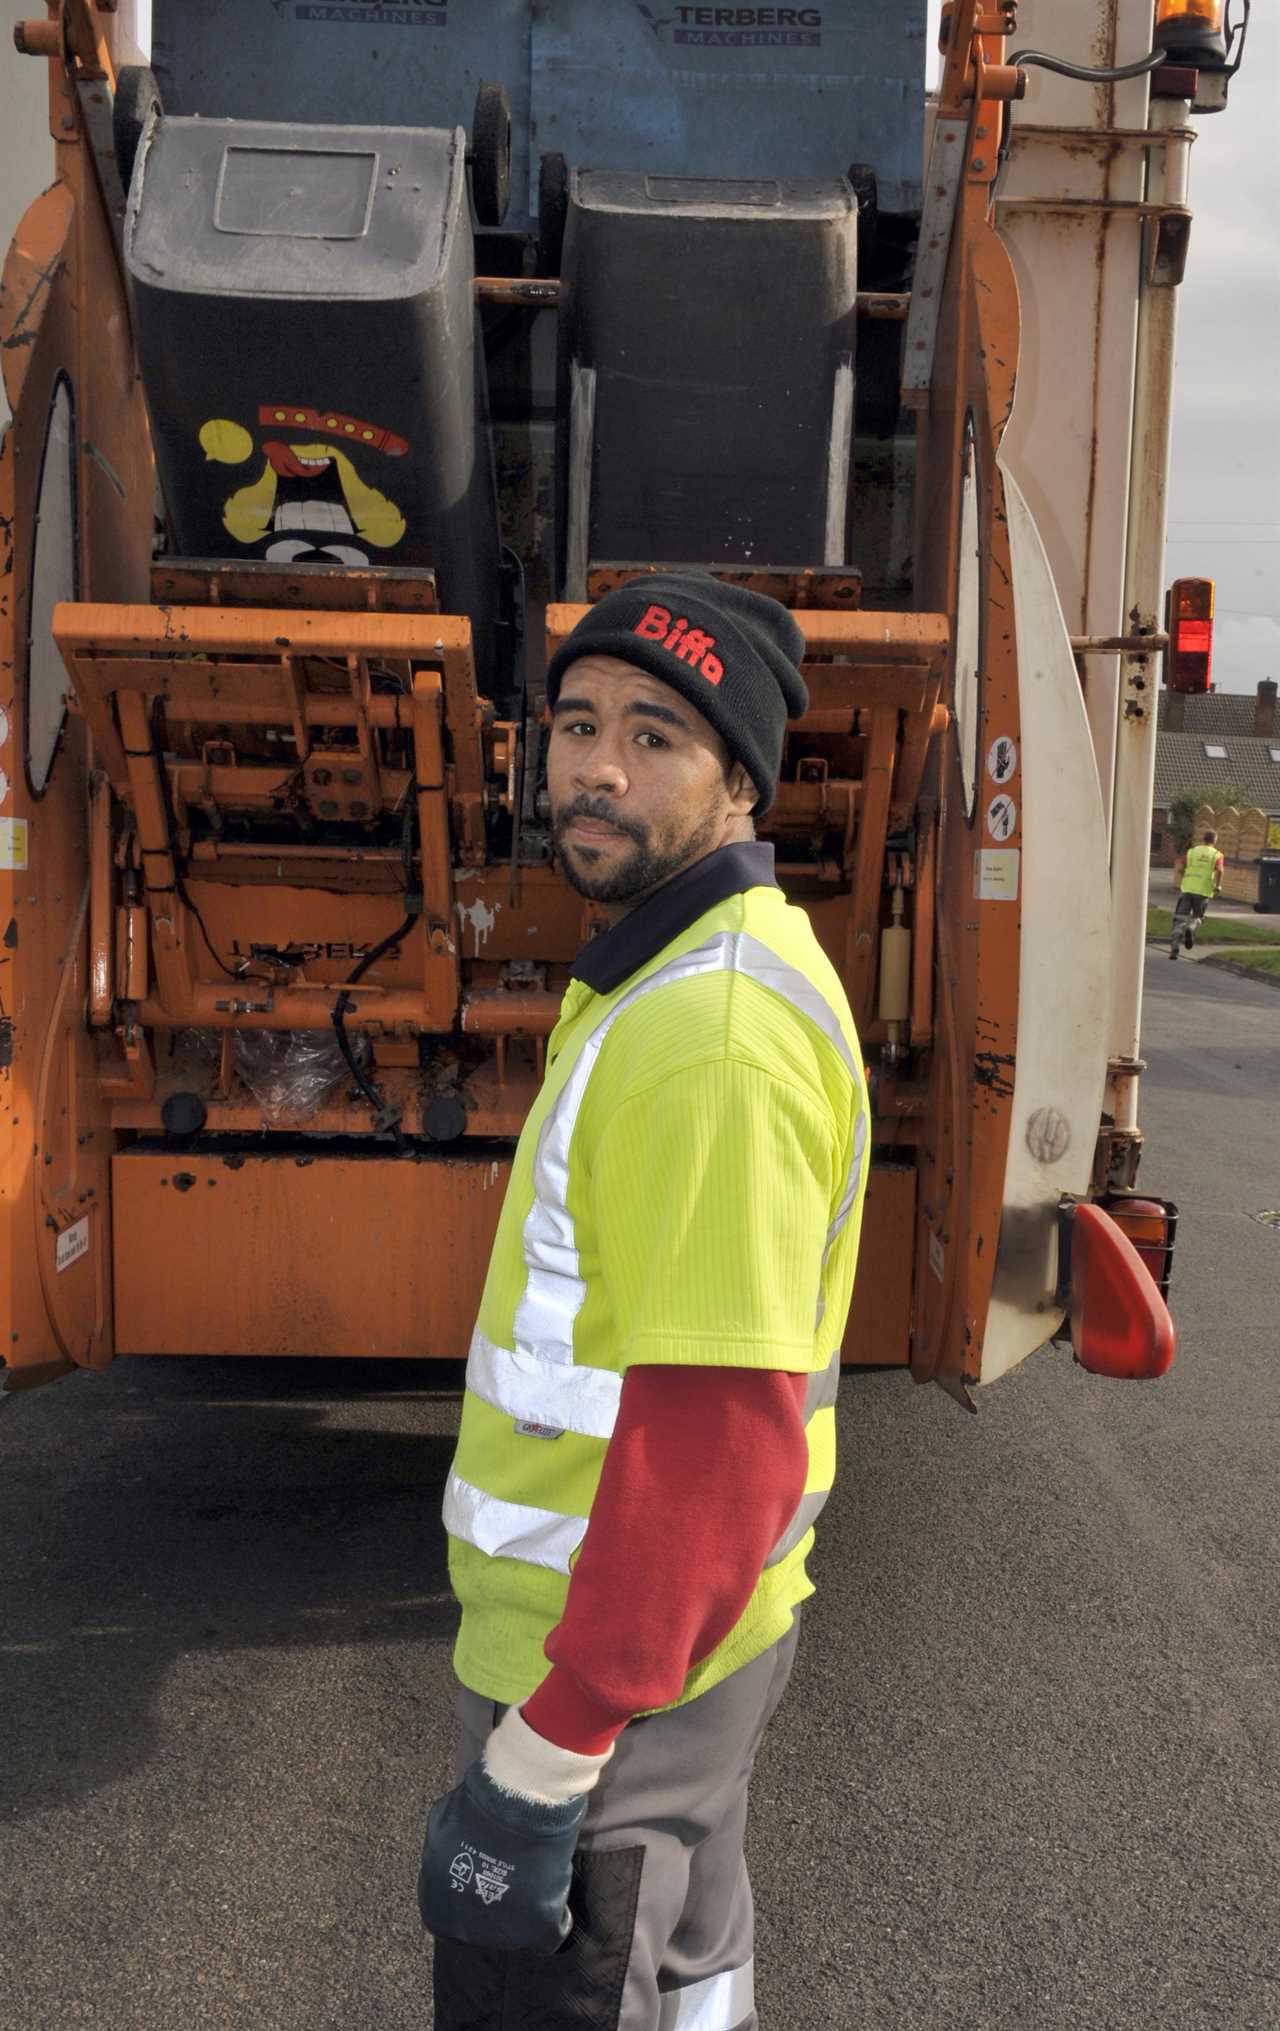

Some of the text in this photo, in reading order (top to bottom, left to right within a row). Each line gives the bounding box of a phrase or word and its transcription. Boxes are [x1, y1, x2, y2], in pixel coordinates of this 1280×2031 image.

[308, 7, 437, 24] MACHINES
[674, 6, 822, 27] TERBERG
[687, 31, 814, 46] MACHINES
[633, 604, 725, 686] Biffa
